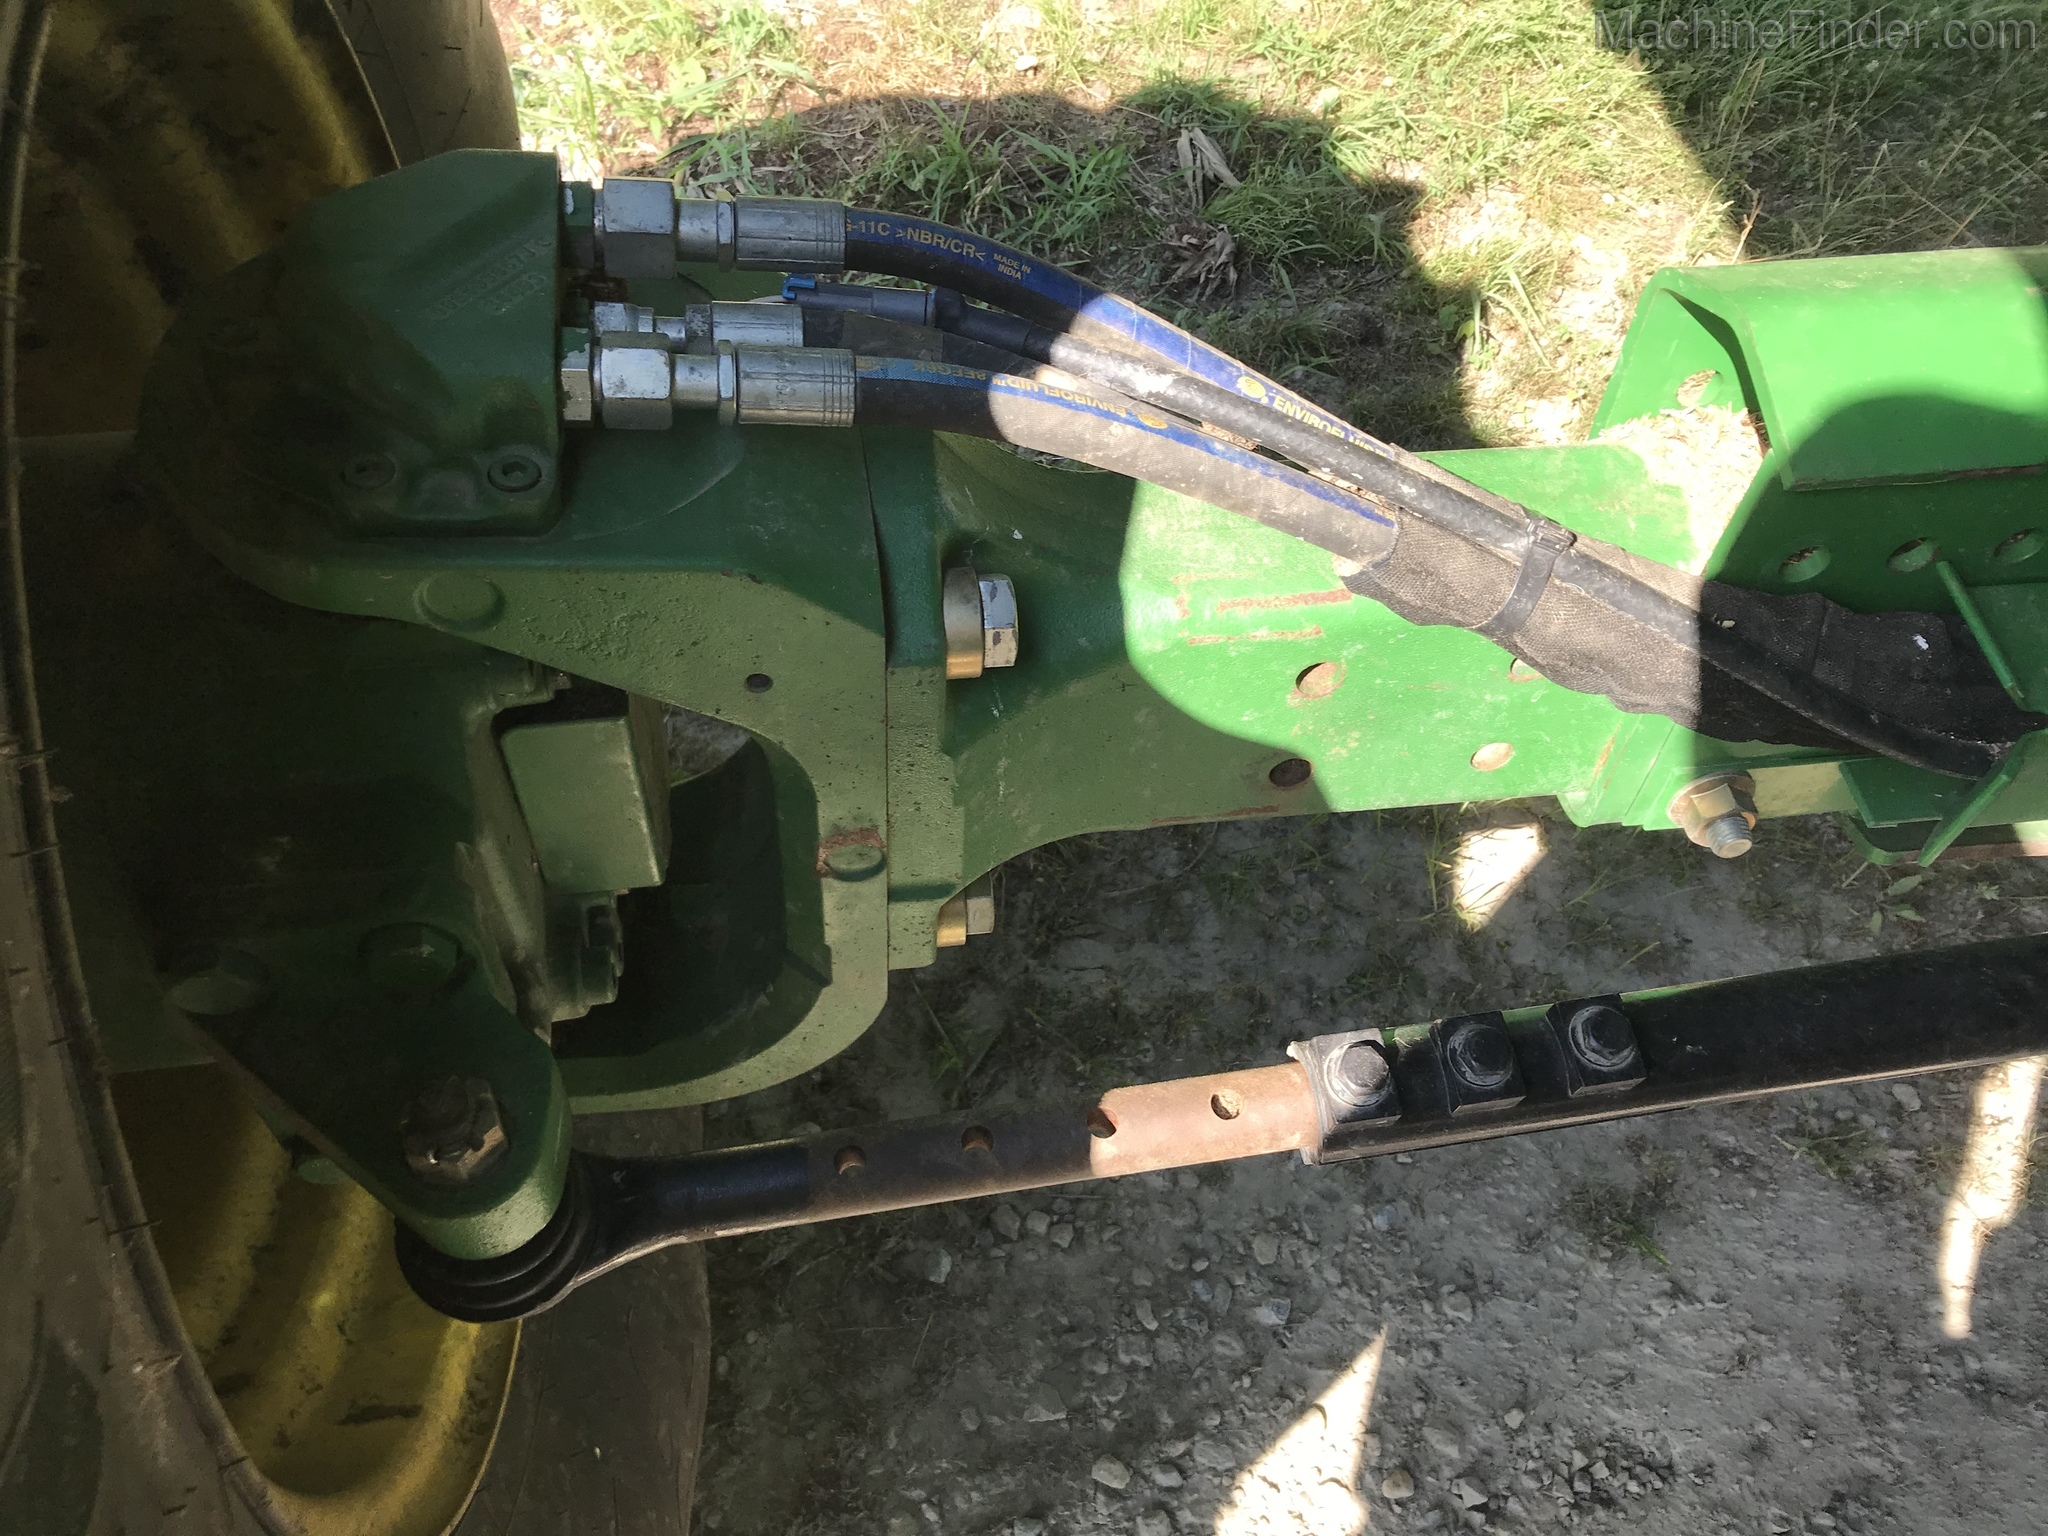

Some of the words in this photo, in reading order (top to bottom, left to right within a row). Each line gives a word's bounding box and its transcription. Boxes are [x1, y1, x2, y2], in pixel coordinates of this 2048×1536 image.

[993, 253, 1020, 270] MADE
[1021, 264, 1031, 274] IN
[997, 263, 1022, 280] INDIA
